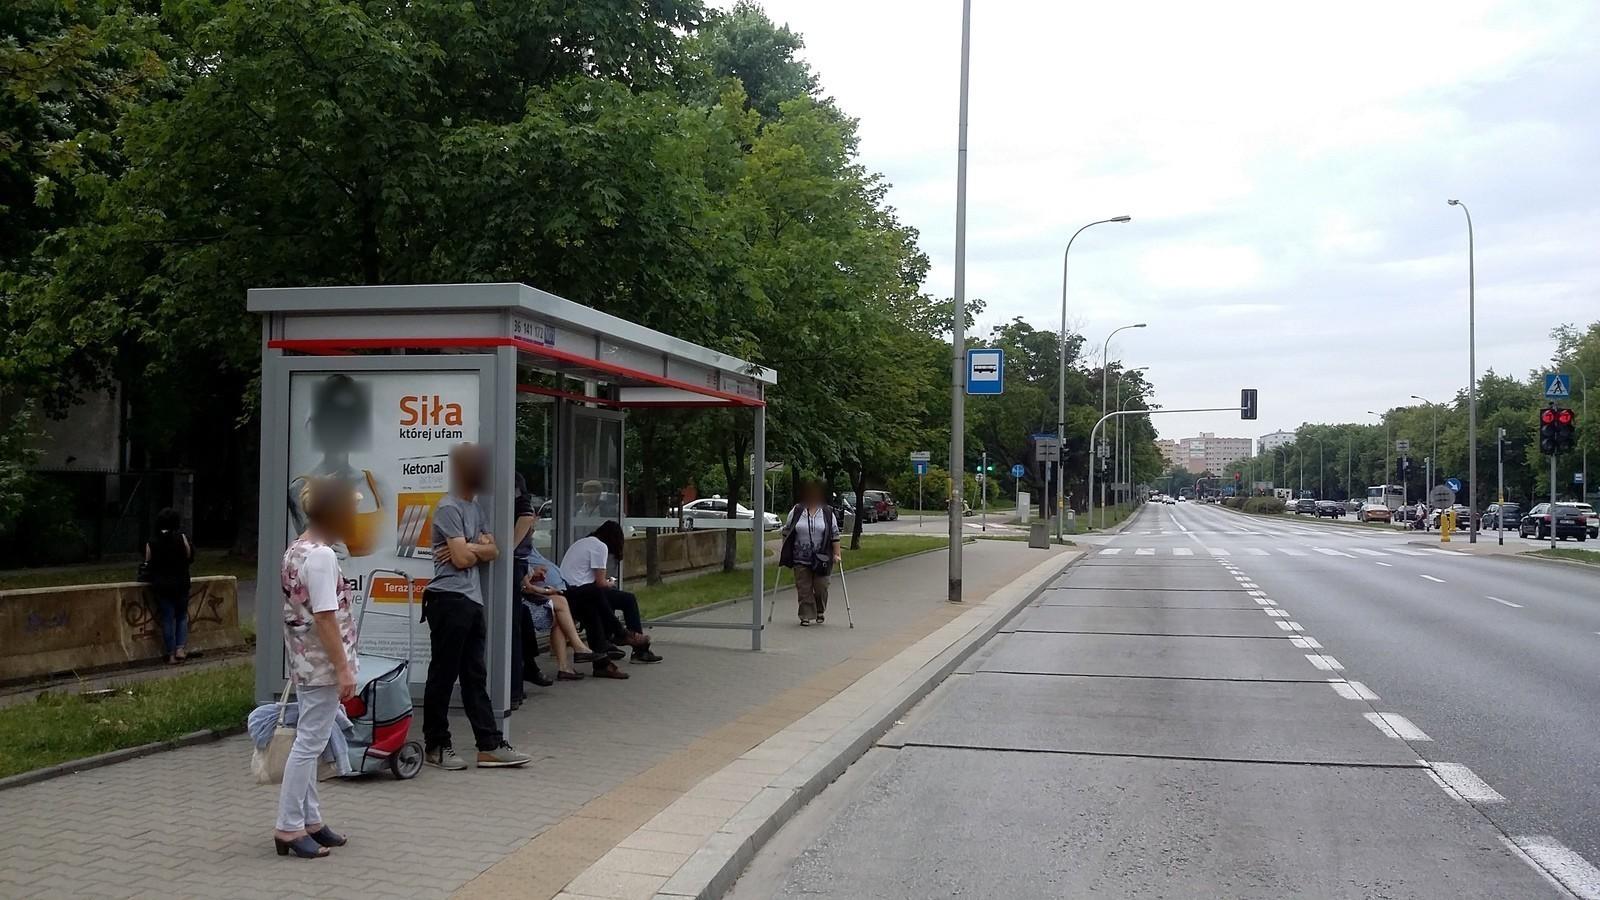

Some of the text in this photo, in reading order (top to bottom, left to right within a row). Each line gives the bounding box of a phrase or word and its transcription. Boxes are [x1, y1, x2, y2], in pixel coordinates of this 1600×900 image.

[399, 395, 463, 426] Siła
[399, 427, 463, 441] której ufam
[402, 460, 443, 475] Ketonal
[383, 582, 409, 593] Teraz
